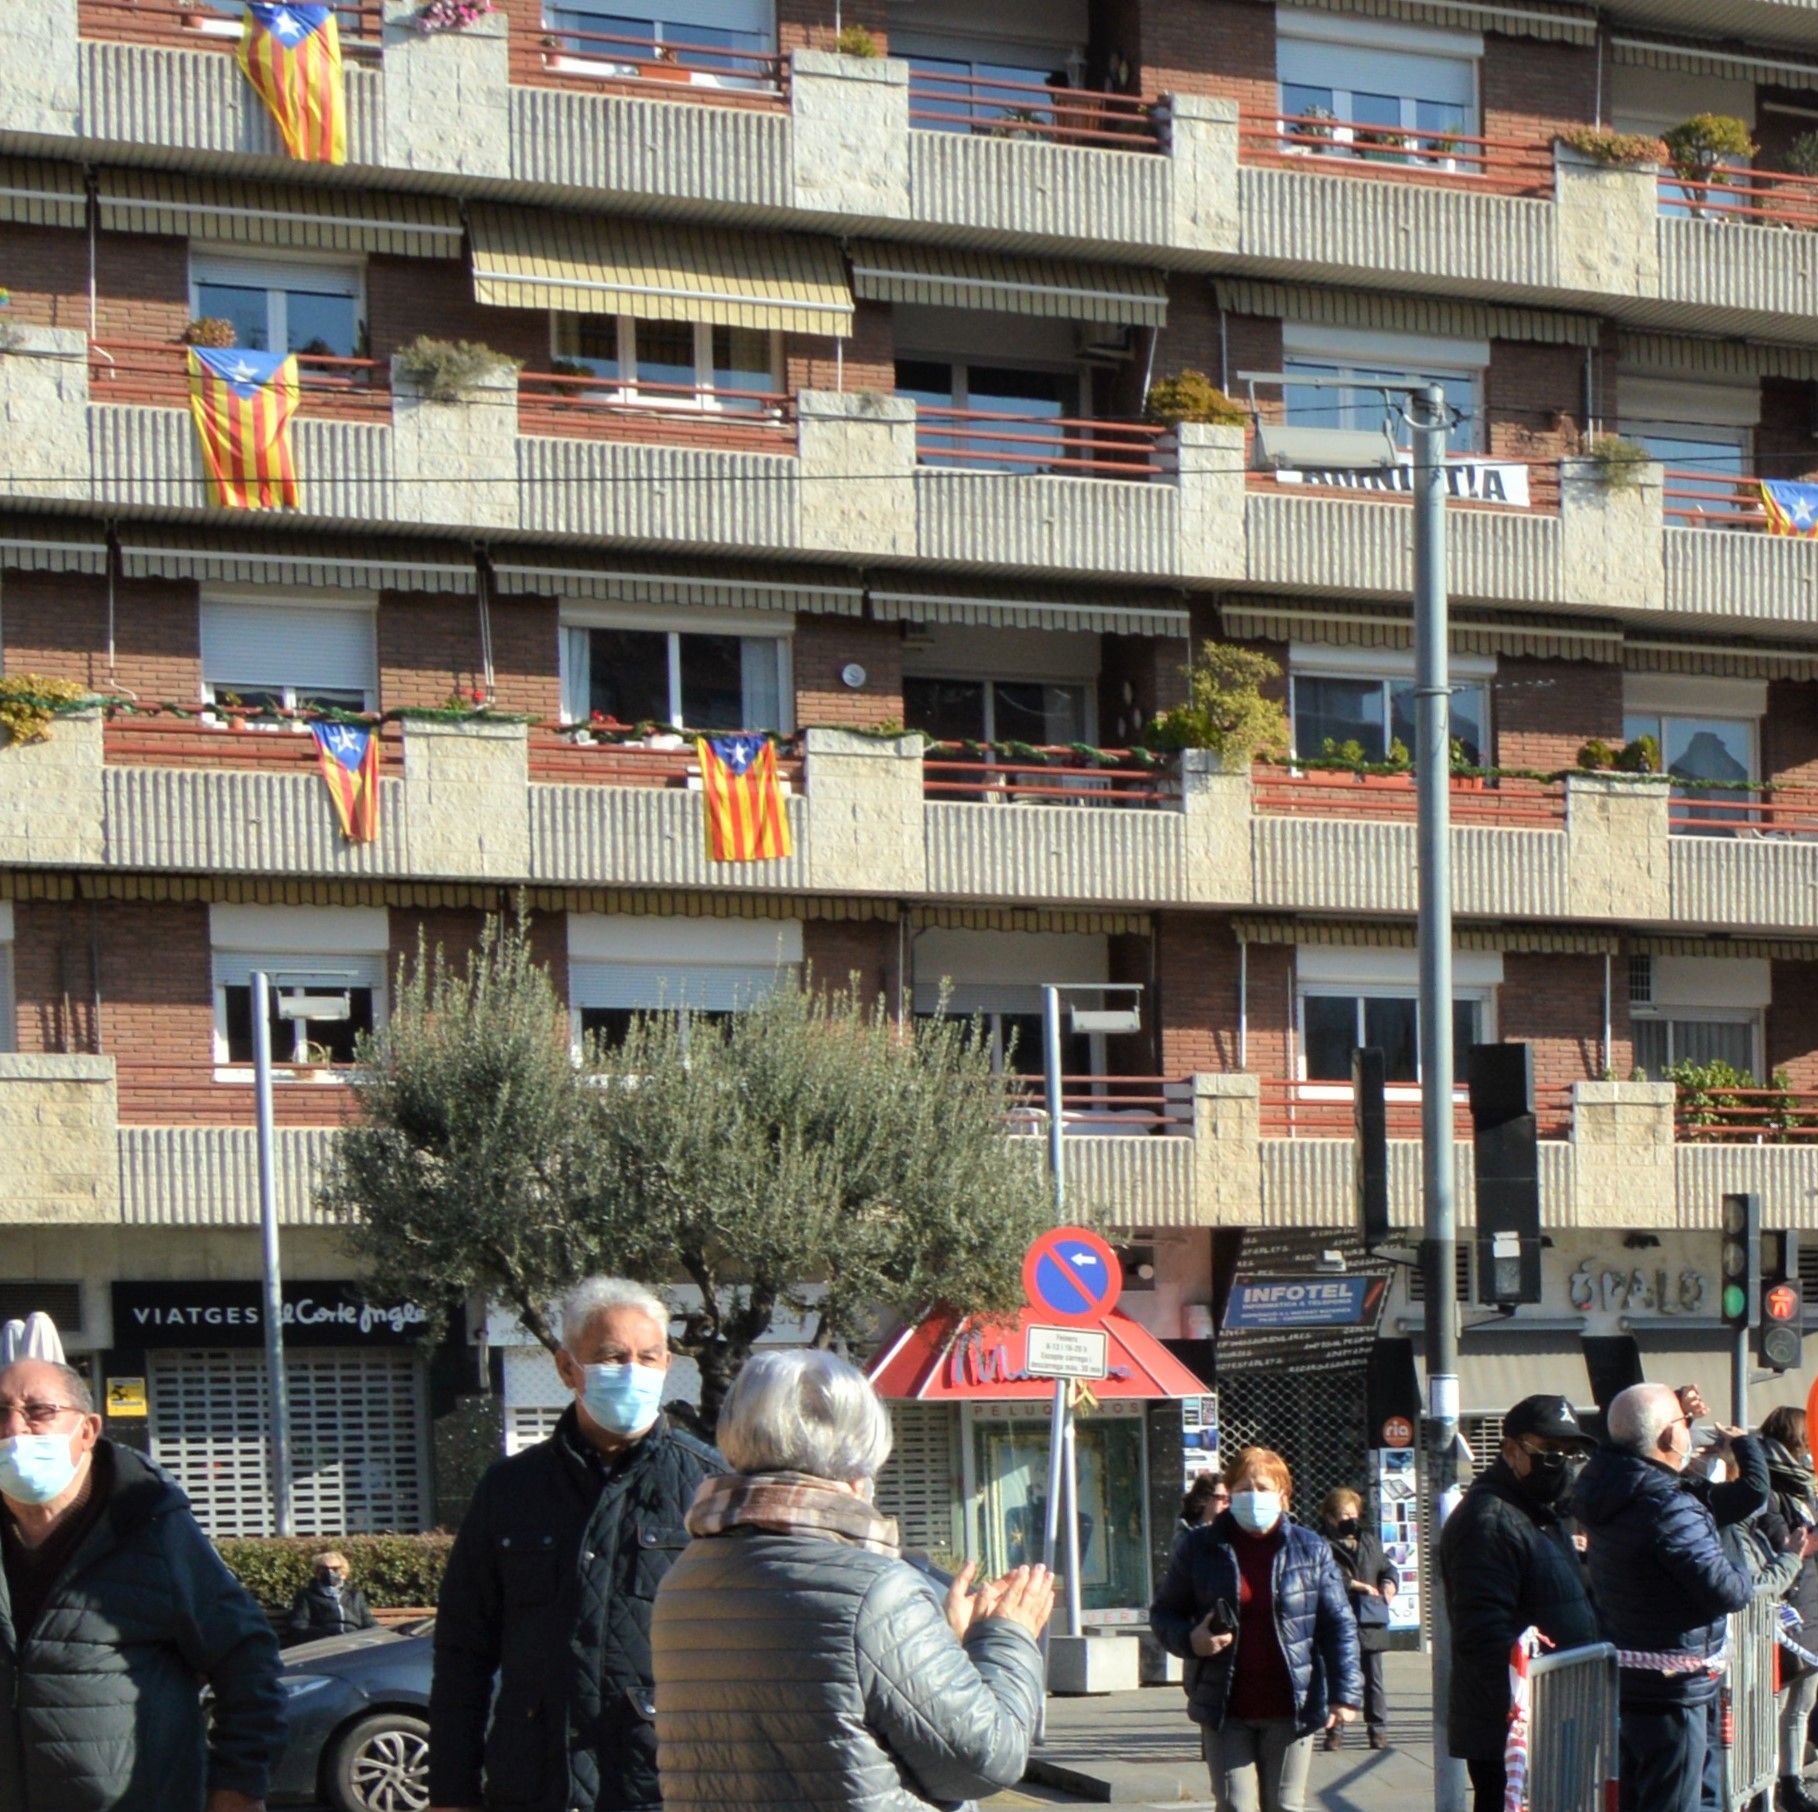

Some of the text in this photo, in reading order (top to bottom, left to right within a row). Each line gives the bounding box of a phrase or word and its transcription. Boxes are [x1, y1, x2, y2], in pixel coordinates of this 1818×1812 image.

[1243, 1283, 1353, 1303] INFOTEL
[133, 1307, 259, 1325] VIATGES
[296, 1299, 357, 1325] Corte
[974, 1402, 1139, 1418] PELUQROS
[1384, 1421, 1410, 1437] ria
